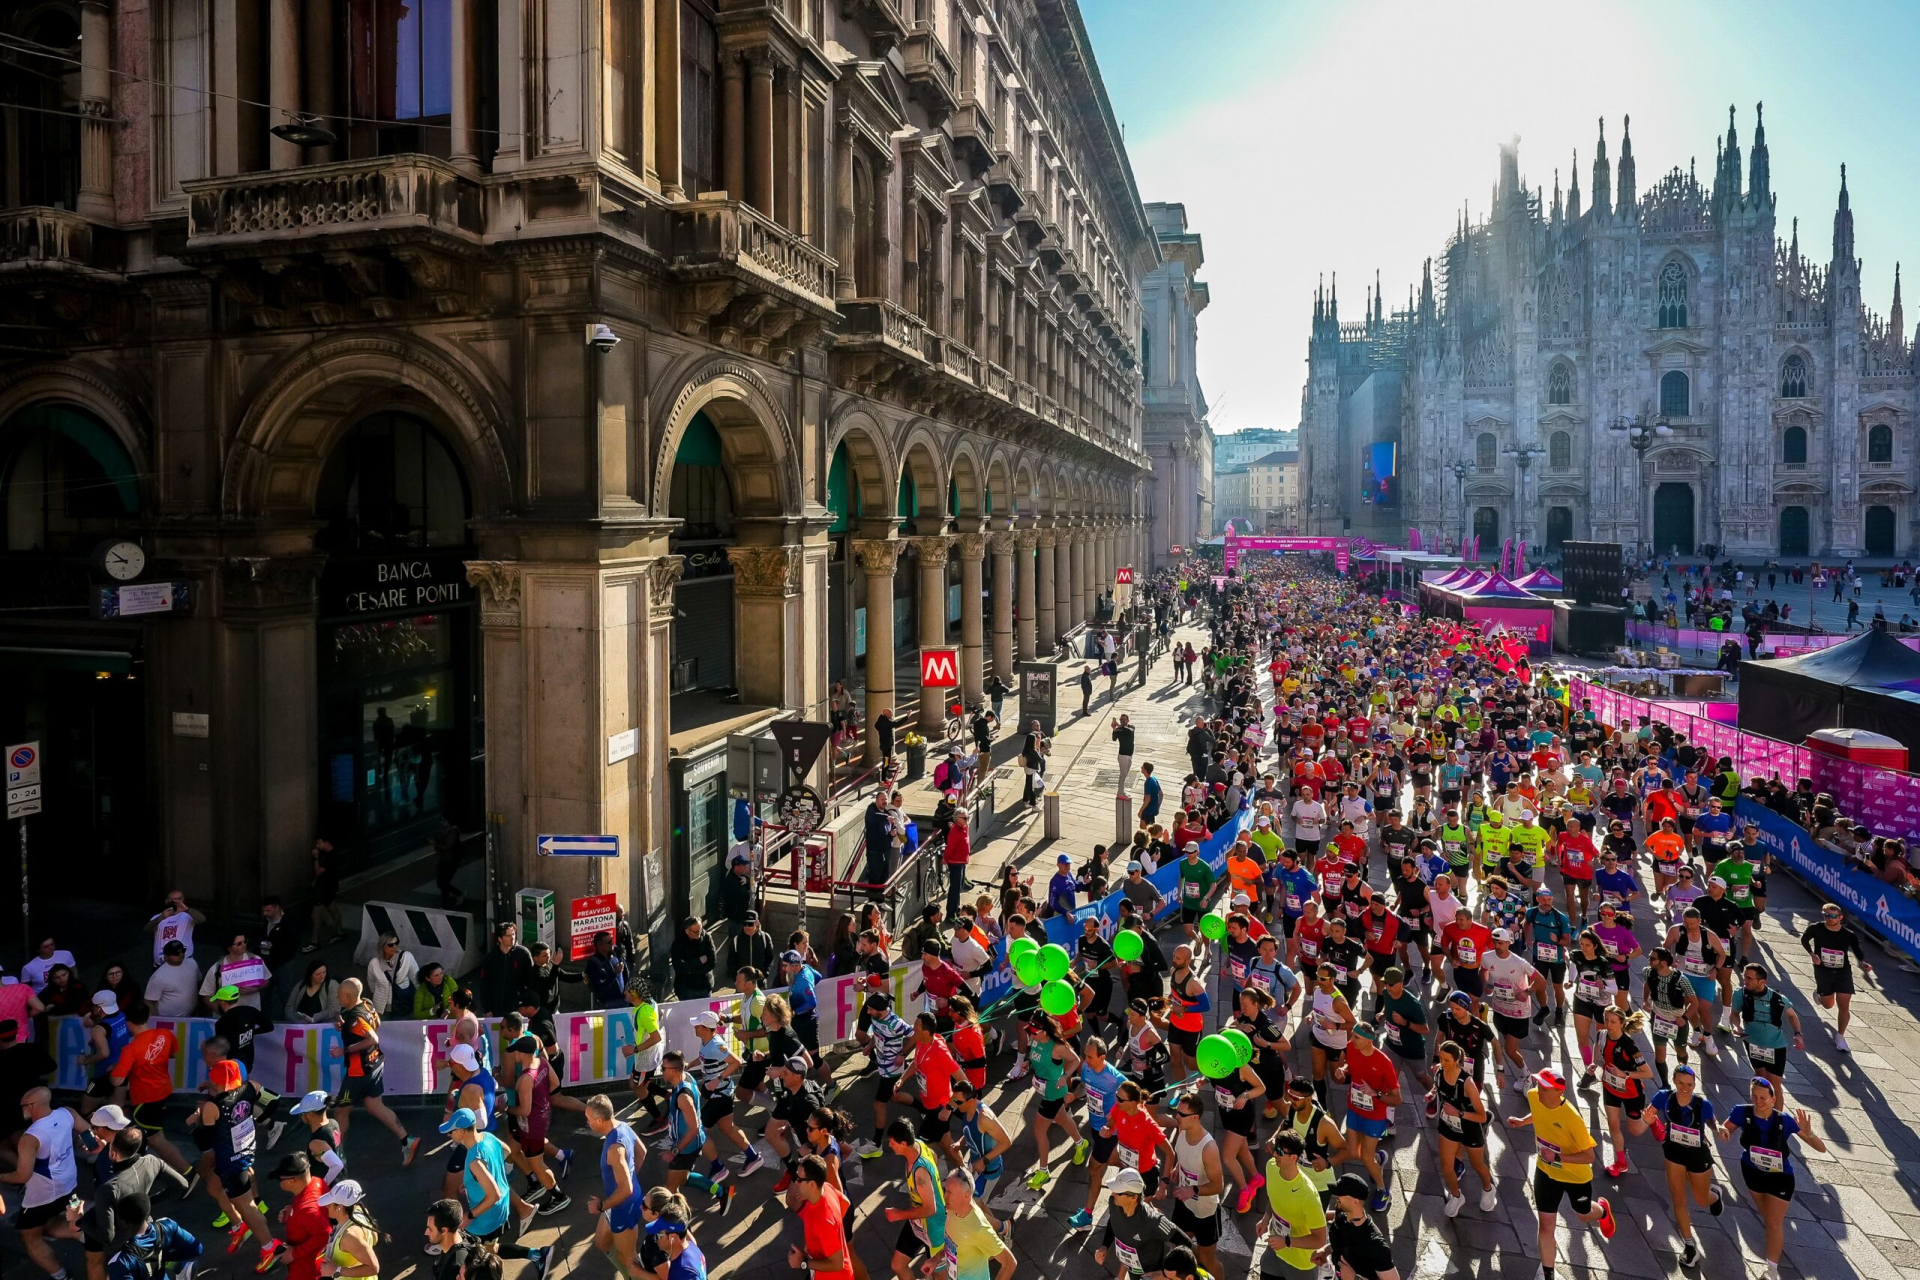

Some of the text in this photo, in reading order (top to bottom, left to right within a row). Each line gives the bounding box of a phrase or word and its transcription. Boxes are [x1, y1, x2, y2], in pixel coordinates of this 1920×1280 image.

[378, 561, 432, 582] BANCA
[1118, 571, 1131, 581] M
[346, 583, 459, 612] CESARE PONTI
[924, 657, 956, 680] M
[1026, 672, 1050, 680] MILANO
[693, 755, 720, 776] SOUVENIR
[25, 788, 37, 797] 24
[1790, 835, 1868, 912] immobiliare.it
[573, 914, 614, 927] MARATONA
[577, 906, 611, 918] PREAVVISO
[580, 924, 599, 933] APRILE
[600, 921, 614, 929] 2025
[569, 1012, 636, 1083] FIA
[284, 1027, 347, 1094] FIA
